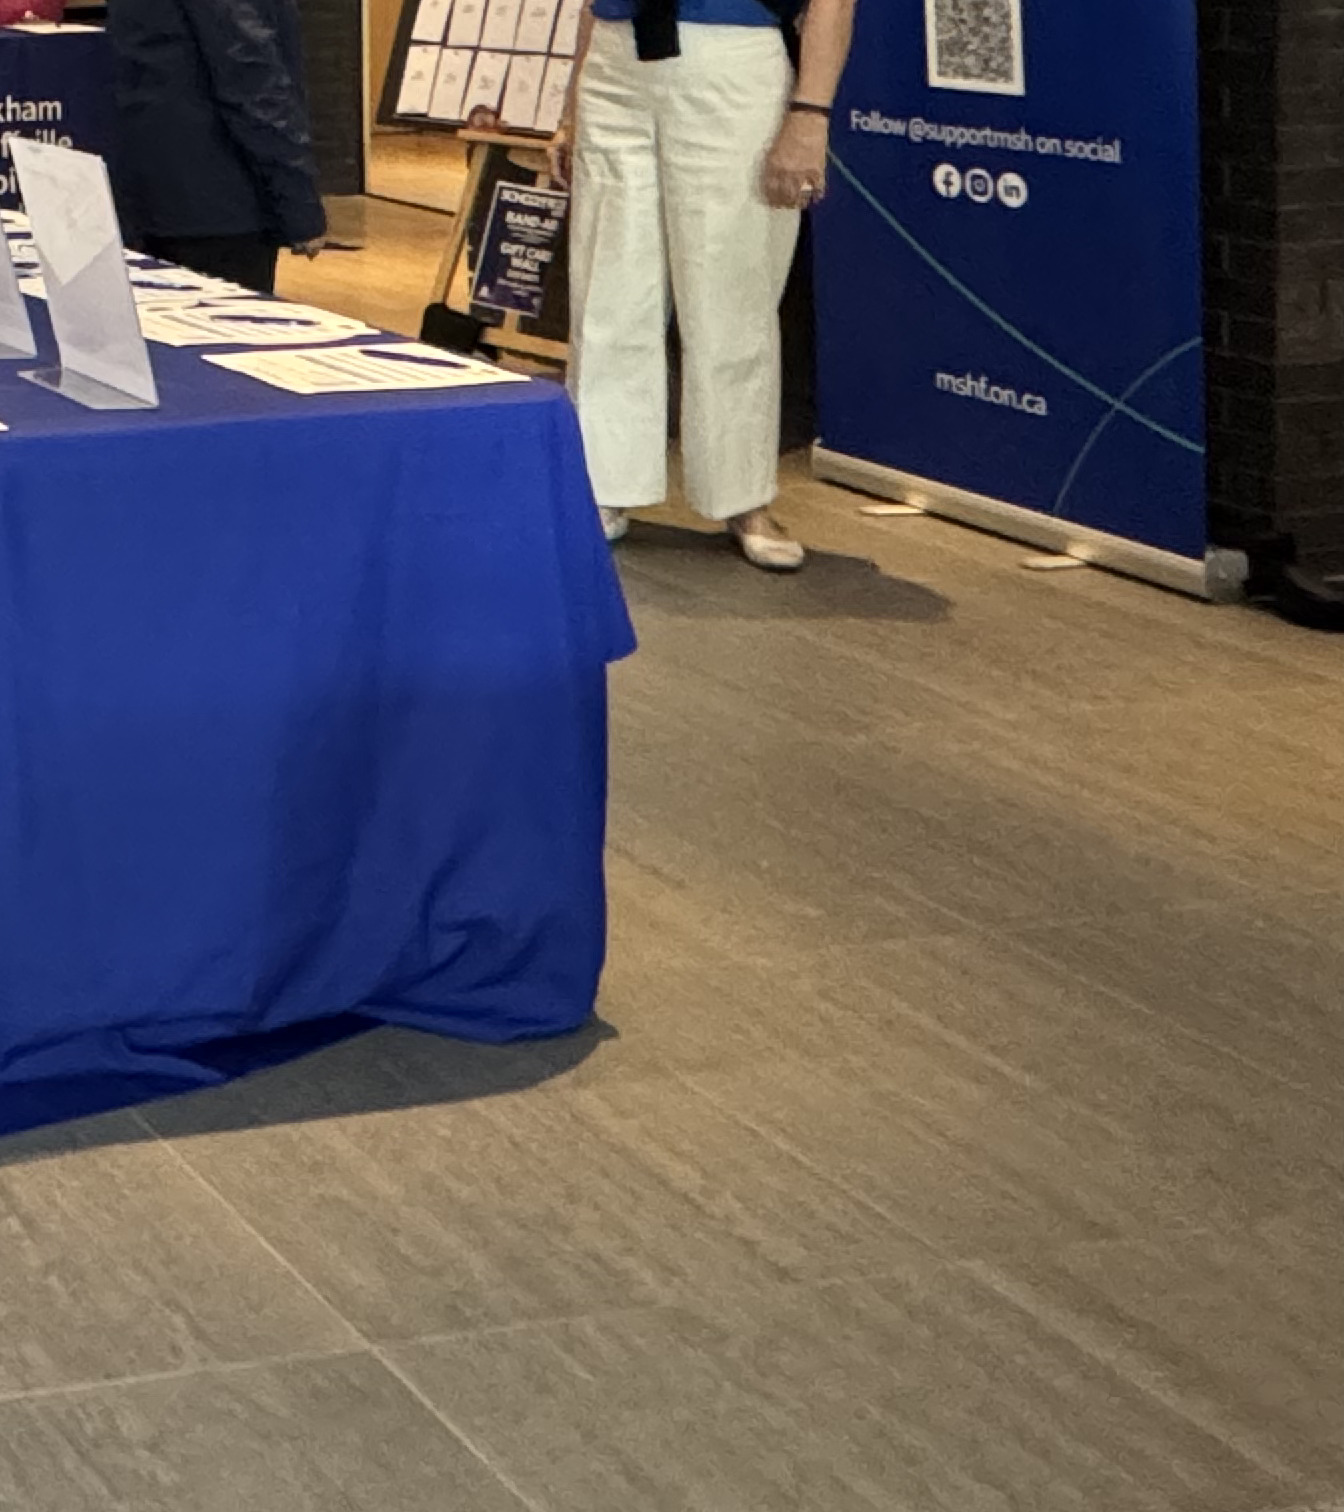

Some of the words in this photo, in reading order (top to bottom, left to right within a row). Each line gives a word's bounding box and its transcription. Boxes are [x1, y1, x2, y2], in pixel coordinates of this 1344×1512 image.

[850, 108, 907, 135] Follow
[908, 117, 1033, 151] @supportmsh
[1035, 137, 1062, 155] on
[1063, 137, 1123, 164] social
[935, 370, 1048, 416] mshf.on.ca
